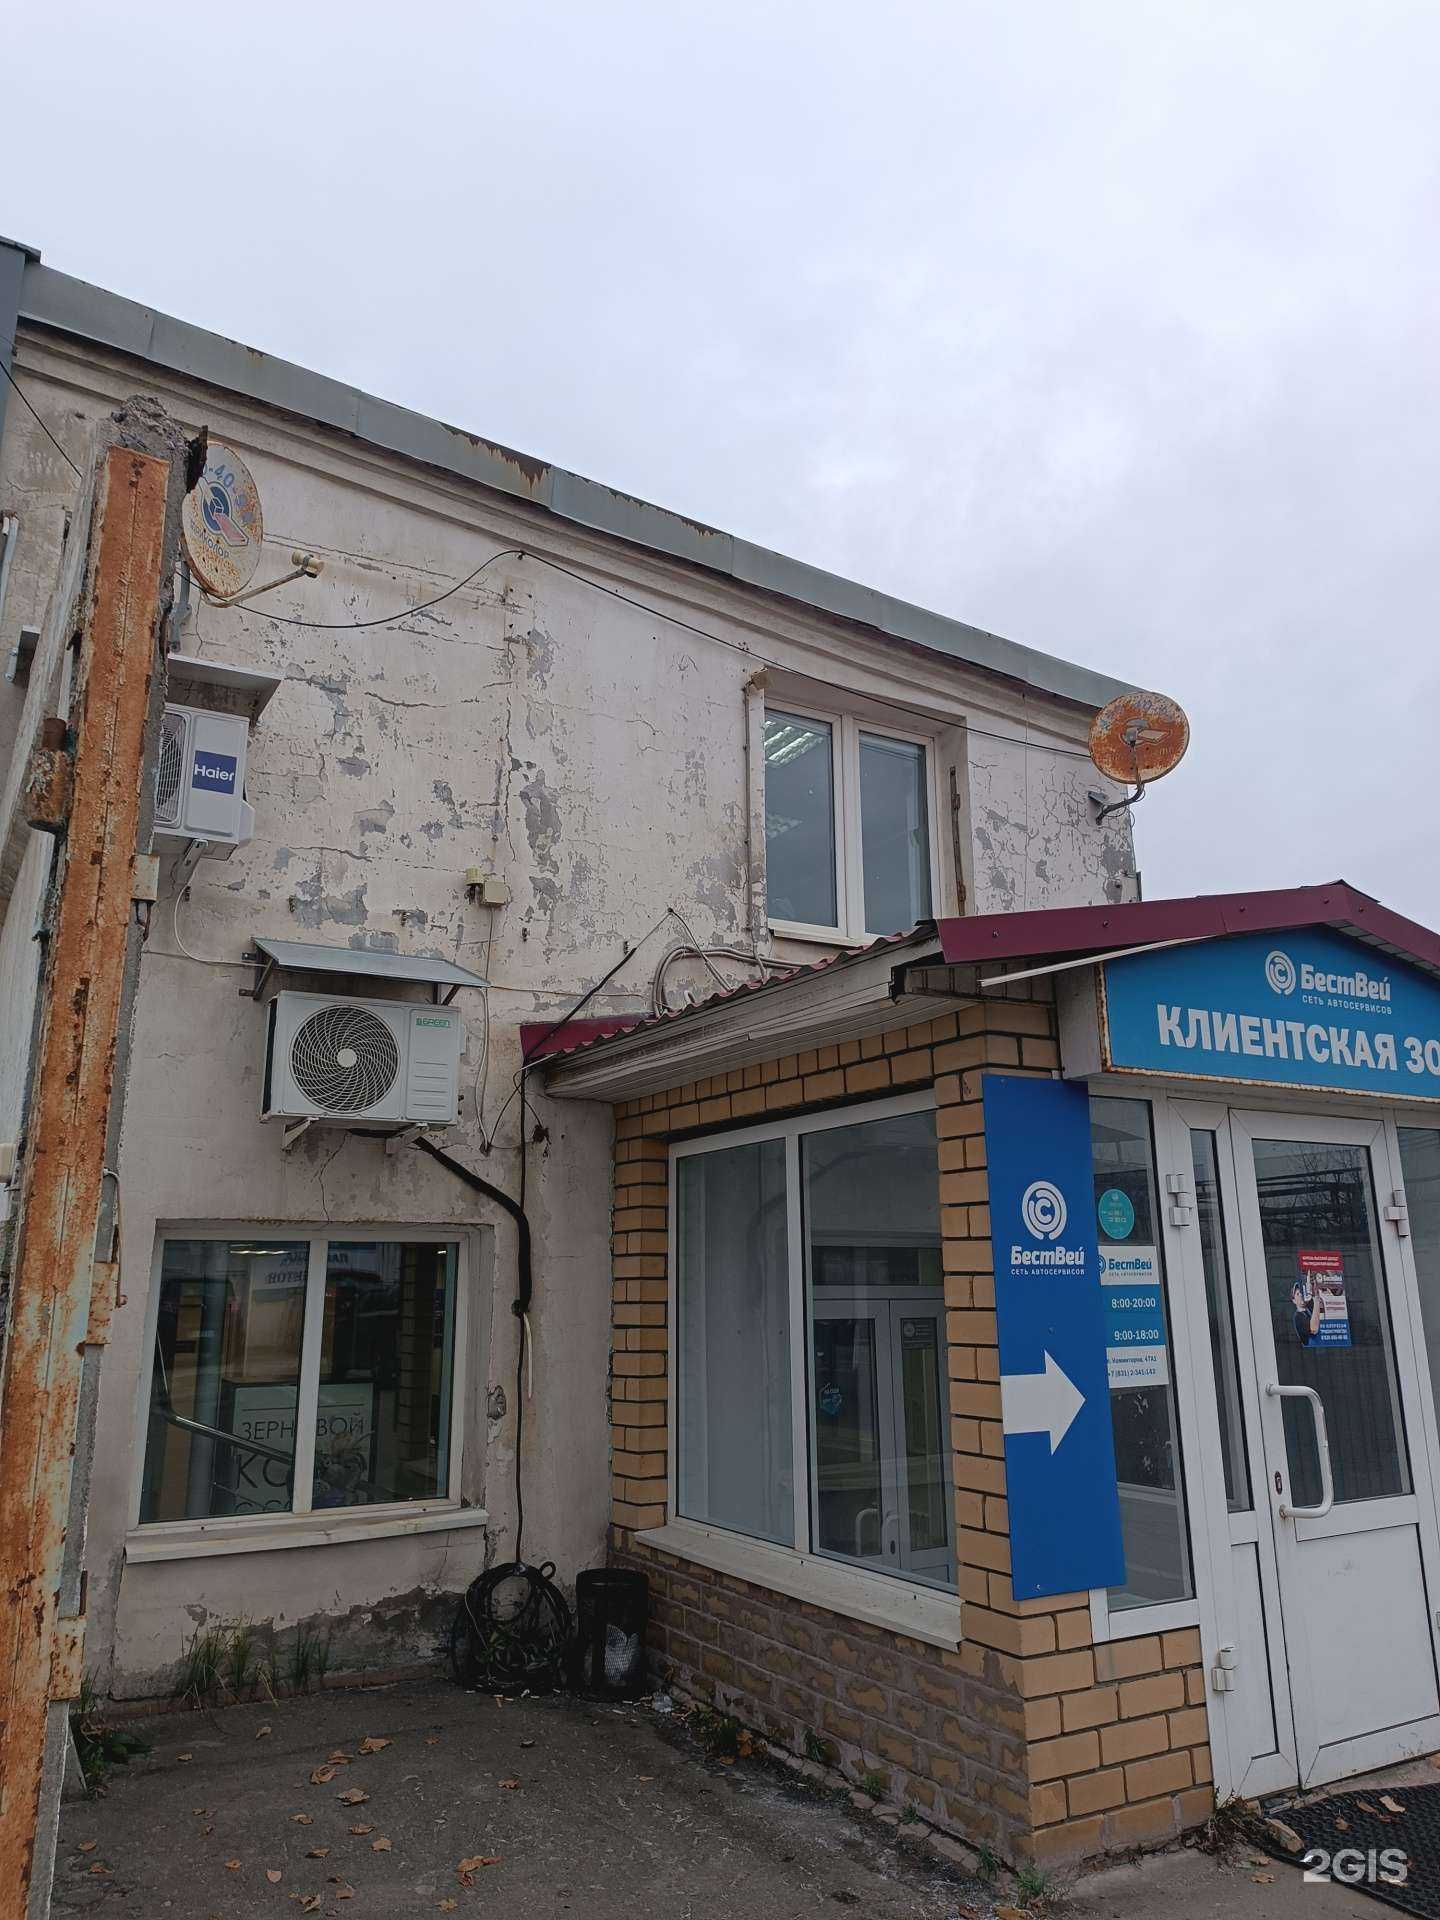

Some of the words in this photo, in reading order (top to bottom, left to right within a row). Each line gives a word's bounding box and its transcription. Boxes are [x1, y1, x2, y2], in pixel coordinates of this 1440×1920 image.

[194, 763, 235, 781] Haier
[1301, 963, 1391, 1001] БестВей
[1302, 995, 1324, 1005] СЕТЬ
[1327, 998, 1392, 1015] АВТОСЕРВИСОВ
[1157, 1004, 1398, 1071] КЛИЕНТСКАЯ
[1010, 1245, 1085, 1265] БестВей
[1108, 1258, 1152, 1270] БестВей
[1011, 1268, 1029, 1276] СЕТЬ
[1111, 1297, 1156, 1309] 8:00-20:00
[1114, 1329, 1159, 1341] 9:00-18:00
[242, 1412, 365, 1440] ЗЕРНВОЙ
